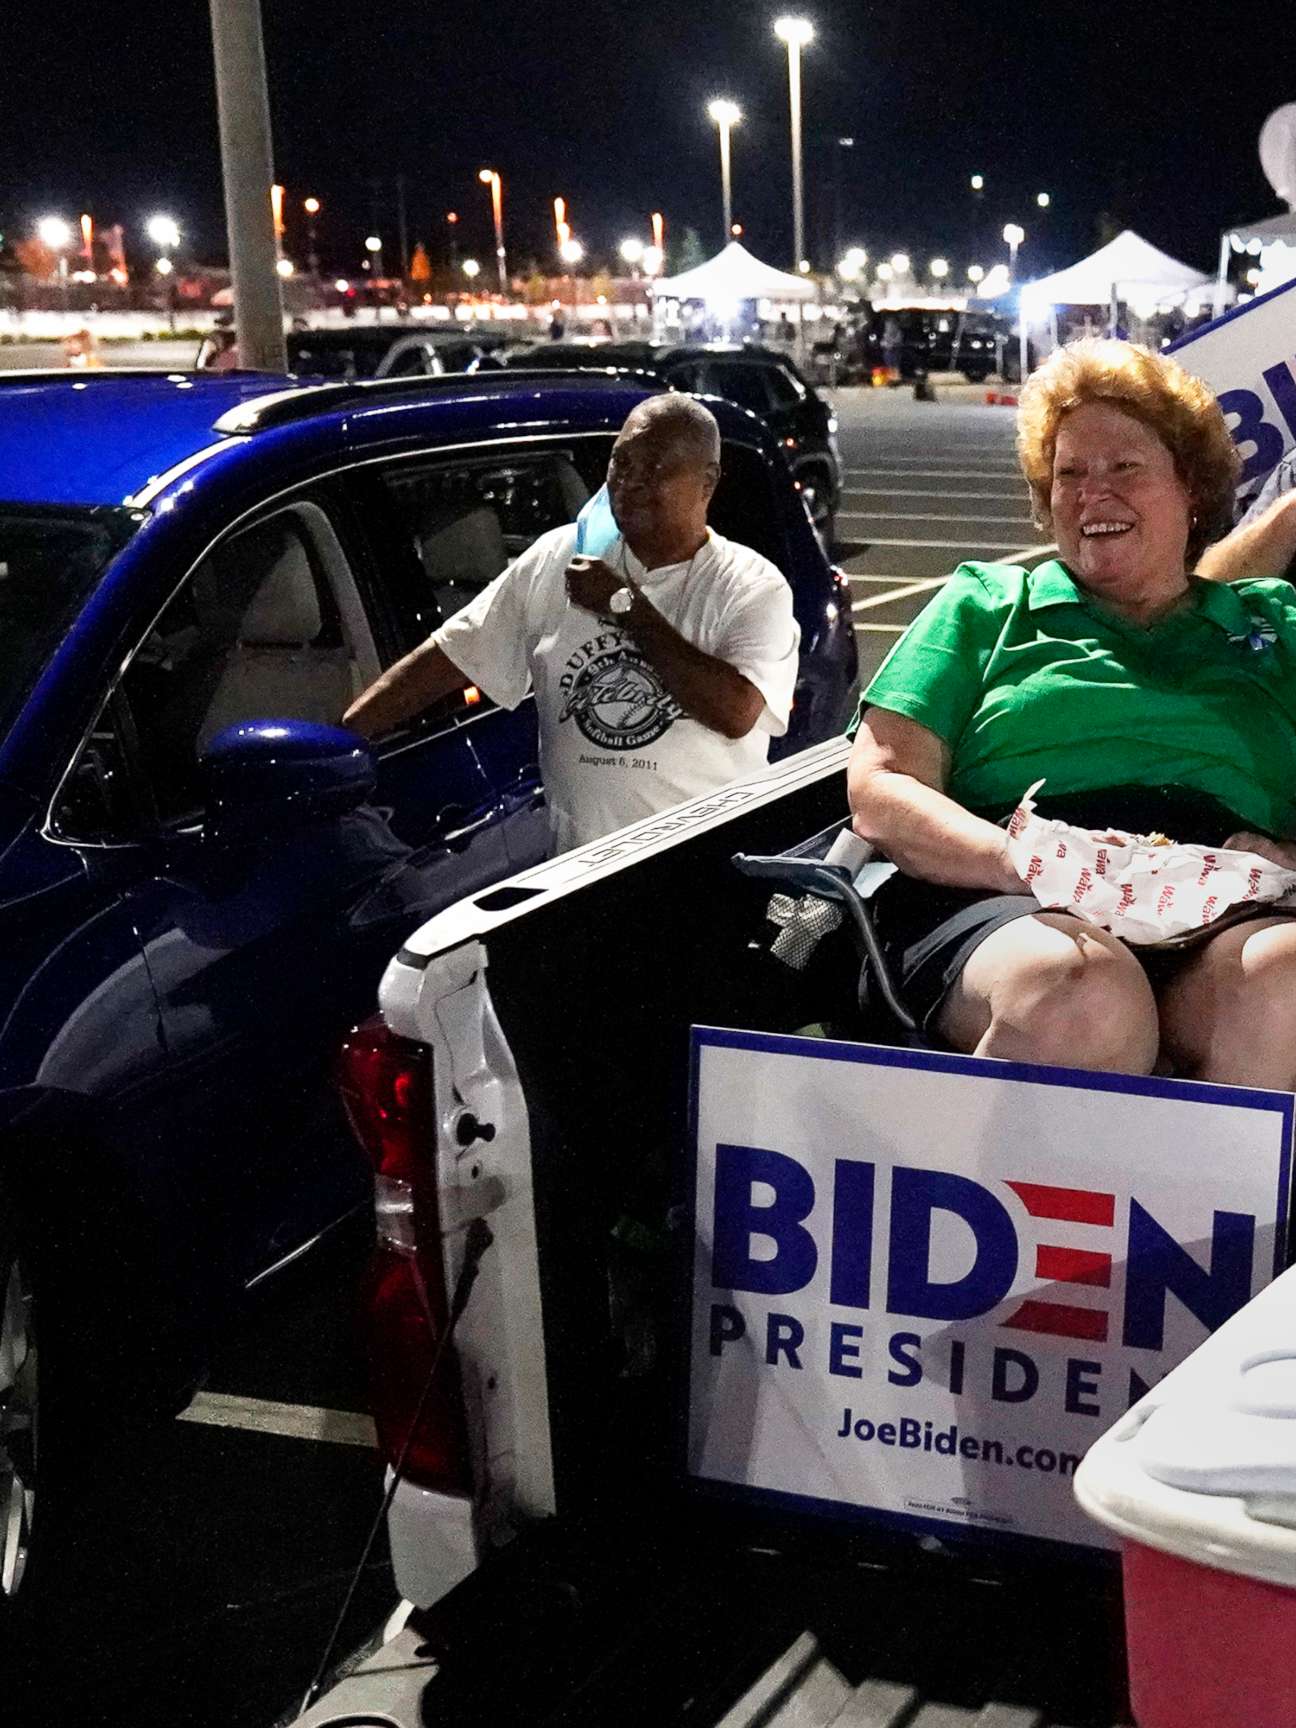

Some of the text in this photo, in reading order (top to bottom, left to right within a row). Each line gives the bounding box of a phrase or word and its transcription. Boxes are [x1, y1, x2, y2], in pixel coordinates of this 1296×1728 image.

[579, 754, 616, 767] August
[632, 758, 657, 771] 2011
[626, 726, 660, 745] Game
[578, 791, 755, 867] CHEVROLET
[711, 1143, 1256, 1351] BIDEN
[708, 1304, 1166, 1417] PRESIDE
